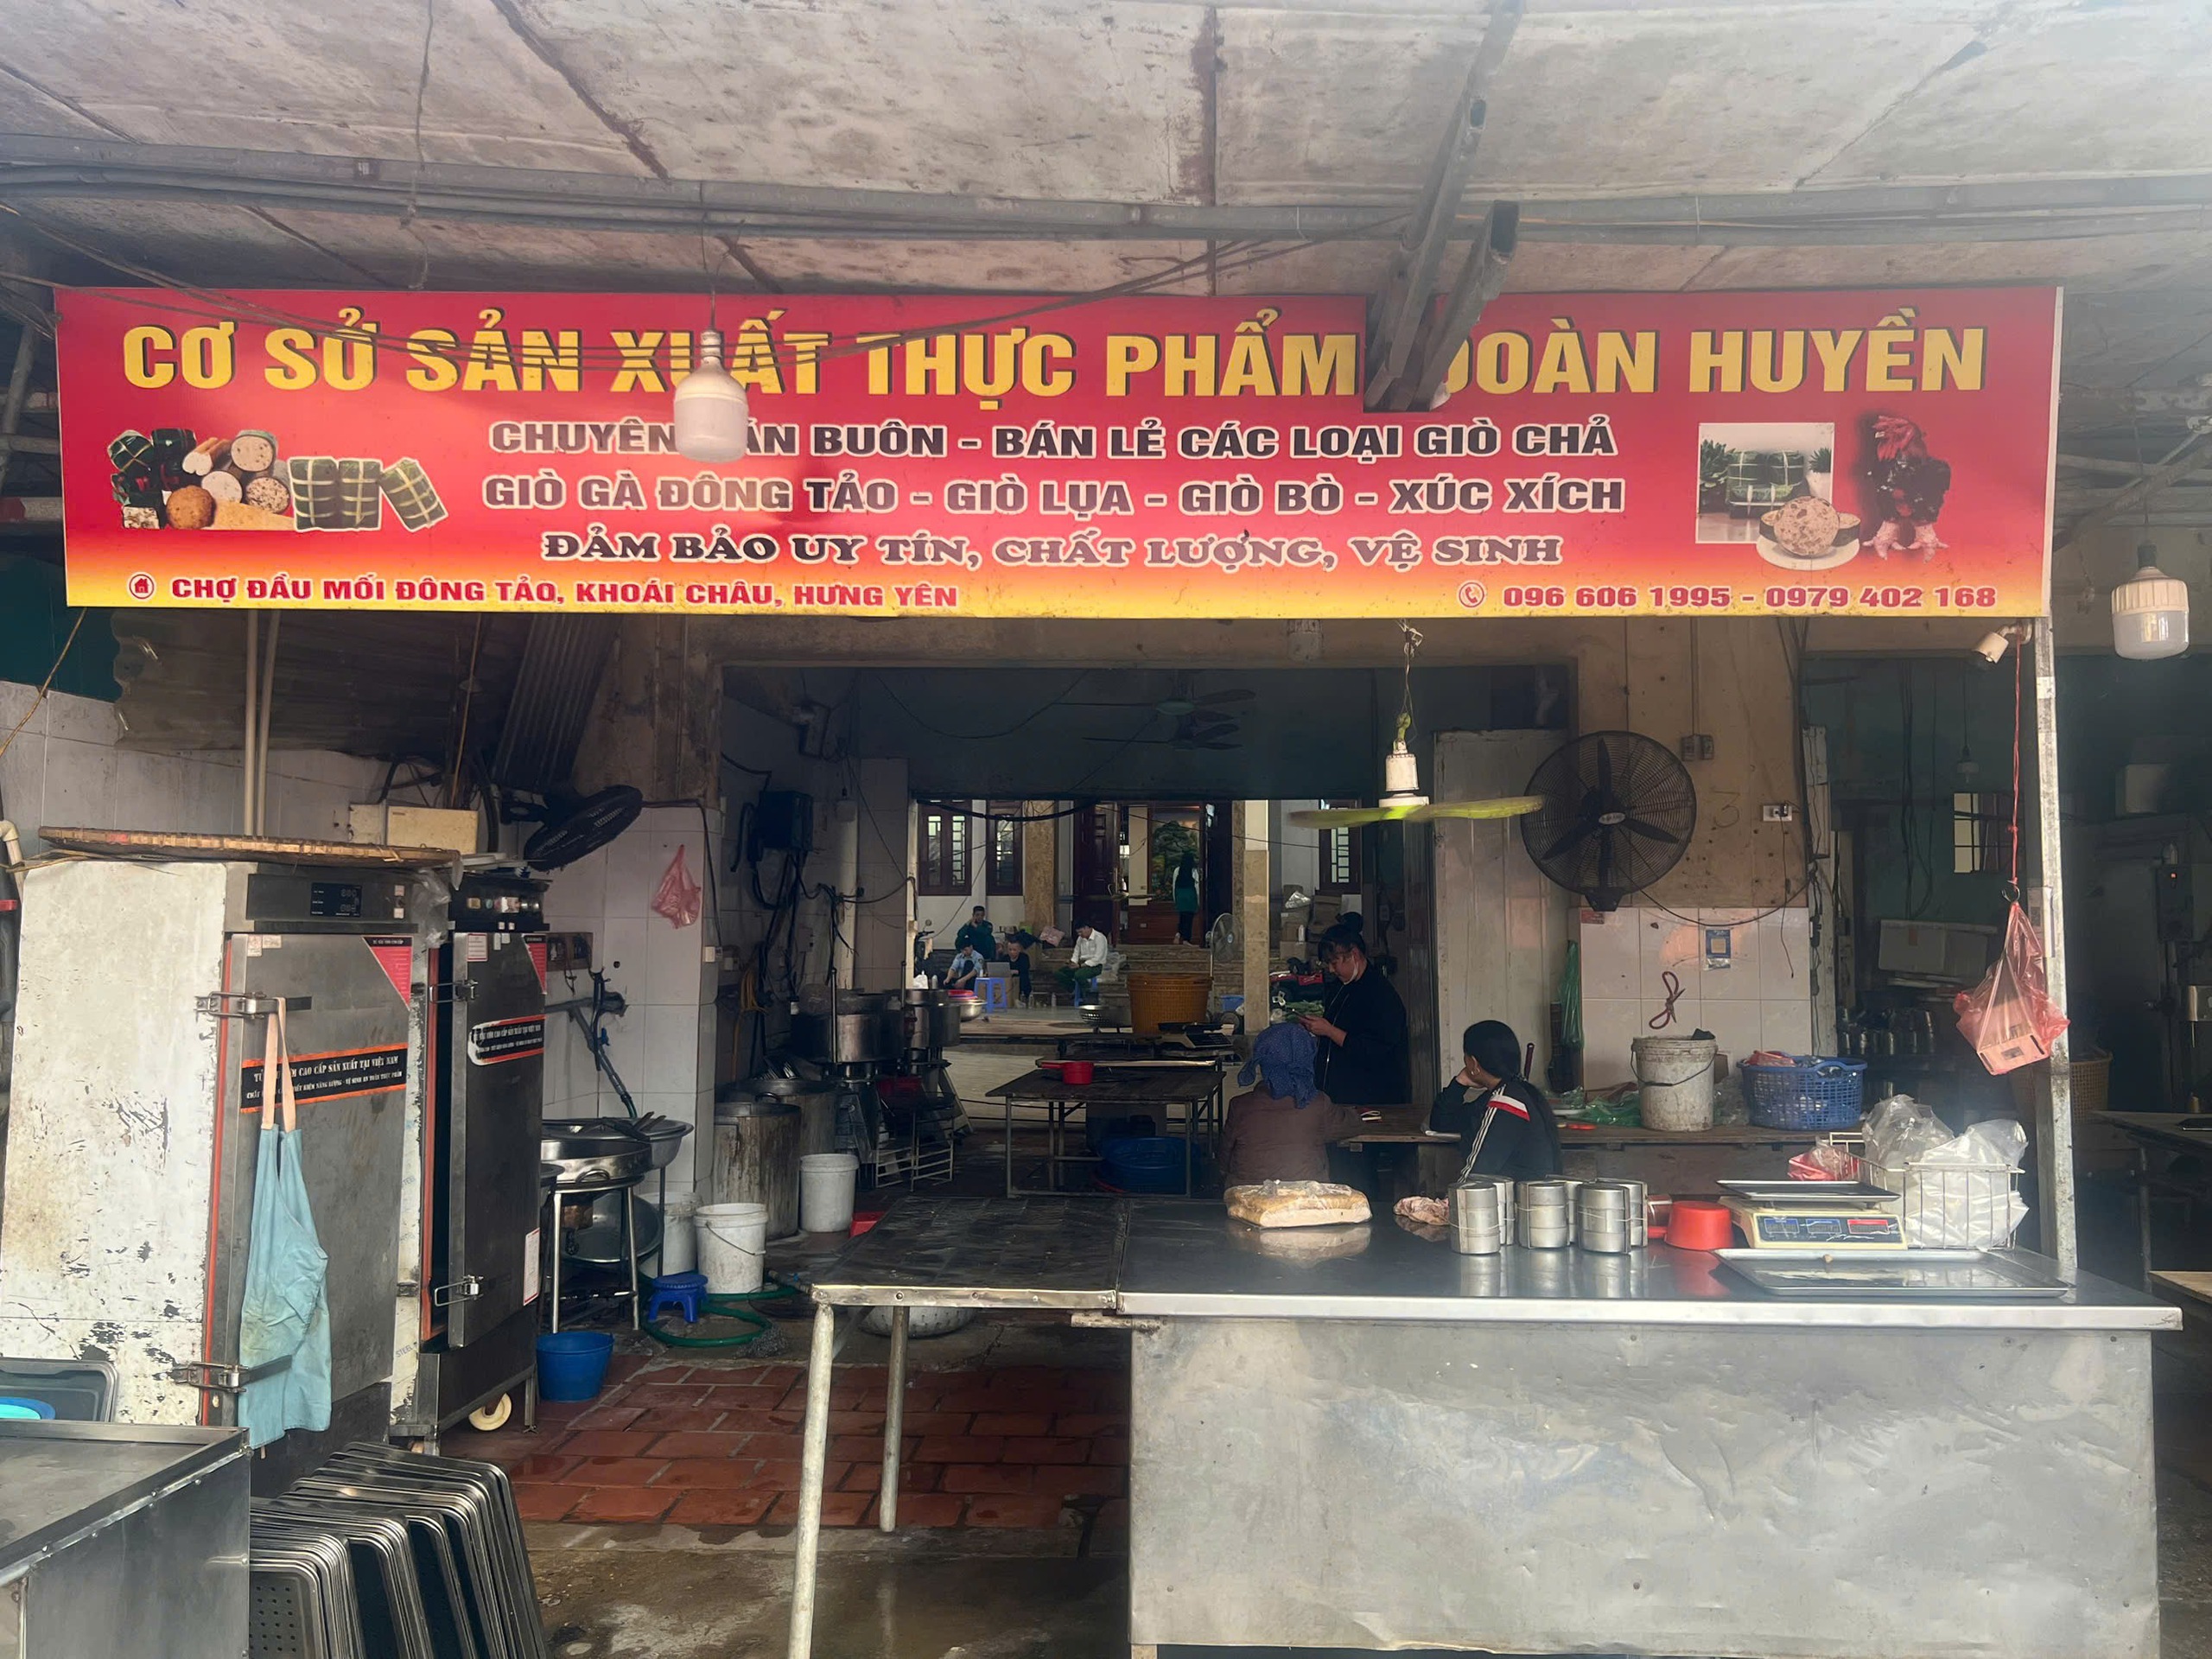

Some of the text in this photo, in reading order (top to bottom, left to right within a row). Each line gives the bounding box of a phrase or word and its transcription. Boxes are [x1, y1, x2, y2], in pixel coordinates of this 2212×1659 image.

[123, 321, 237, 391] CƠ
[264, 306, 379, 391] SỞ
[405, 307, 582, 393] SẢN
[857, 325, 1077, 410] THỰC
[1106, 308, 1360, 397] PHẨM
[1446, 316, 1660, 396] OÀN
[1688, 307, 1986, 394] HUYỀN
[491, 414, 1618, 463] CHUYÊN ÁN BUÔN - BÁN LẺ CÁC LOẠI GIÒ CHẢ
[484, 471, 1625, 521] GIÒ GÀ ĐÔNG TẢO - GIÒ LỤA - GIÒ BÒ - XÚC XÍCH
[542, 524, 1564, 572] ĐẢM BẢO UY TÍN, CHẤT LƯỢNG, VỆ SINH
[172, 571, 957, 607] CHỢ ĐẦU MỐI ĐÔNG TẢO, KHOÁI CHÂU, HƯNG YÊN
[1503, 588, 1563, 607] 096
[1575, 588, 1637, 607] 606
[1650, 588, 1731, 607] 1995
[1765, 588, 1848, 607] 0979
[1859, 588, 1922, 607] 402
[1936, 588, 1996, 607] 168
[299, 1068, 312, 1077] CAO
